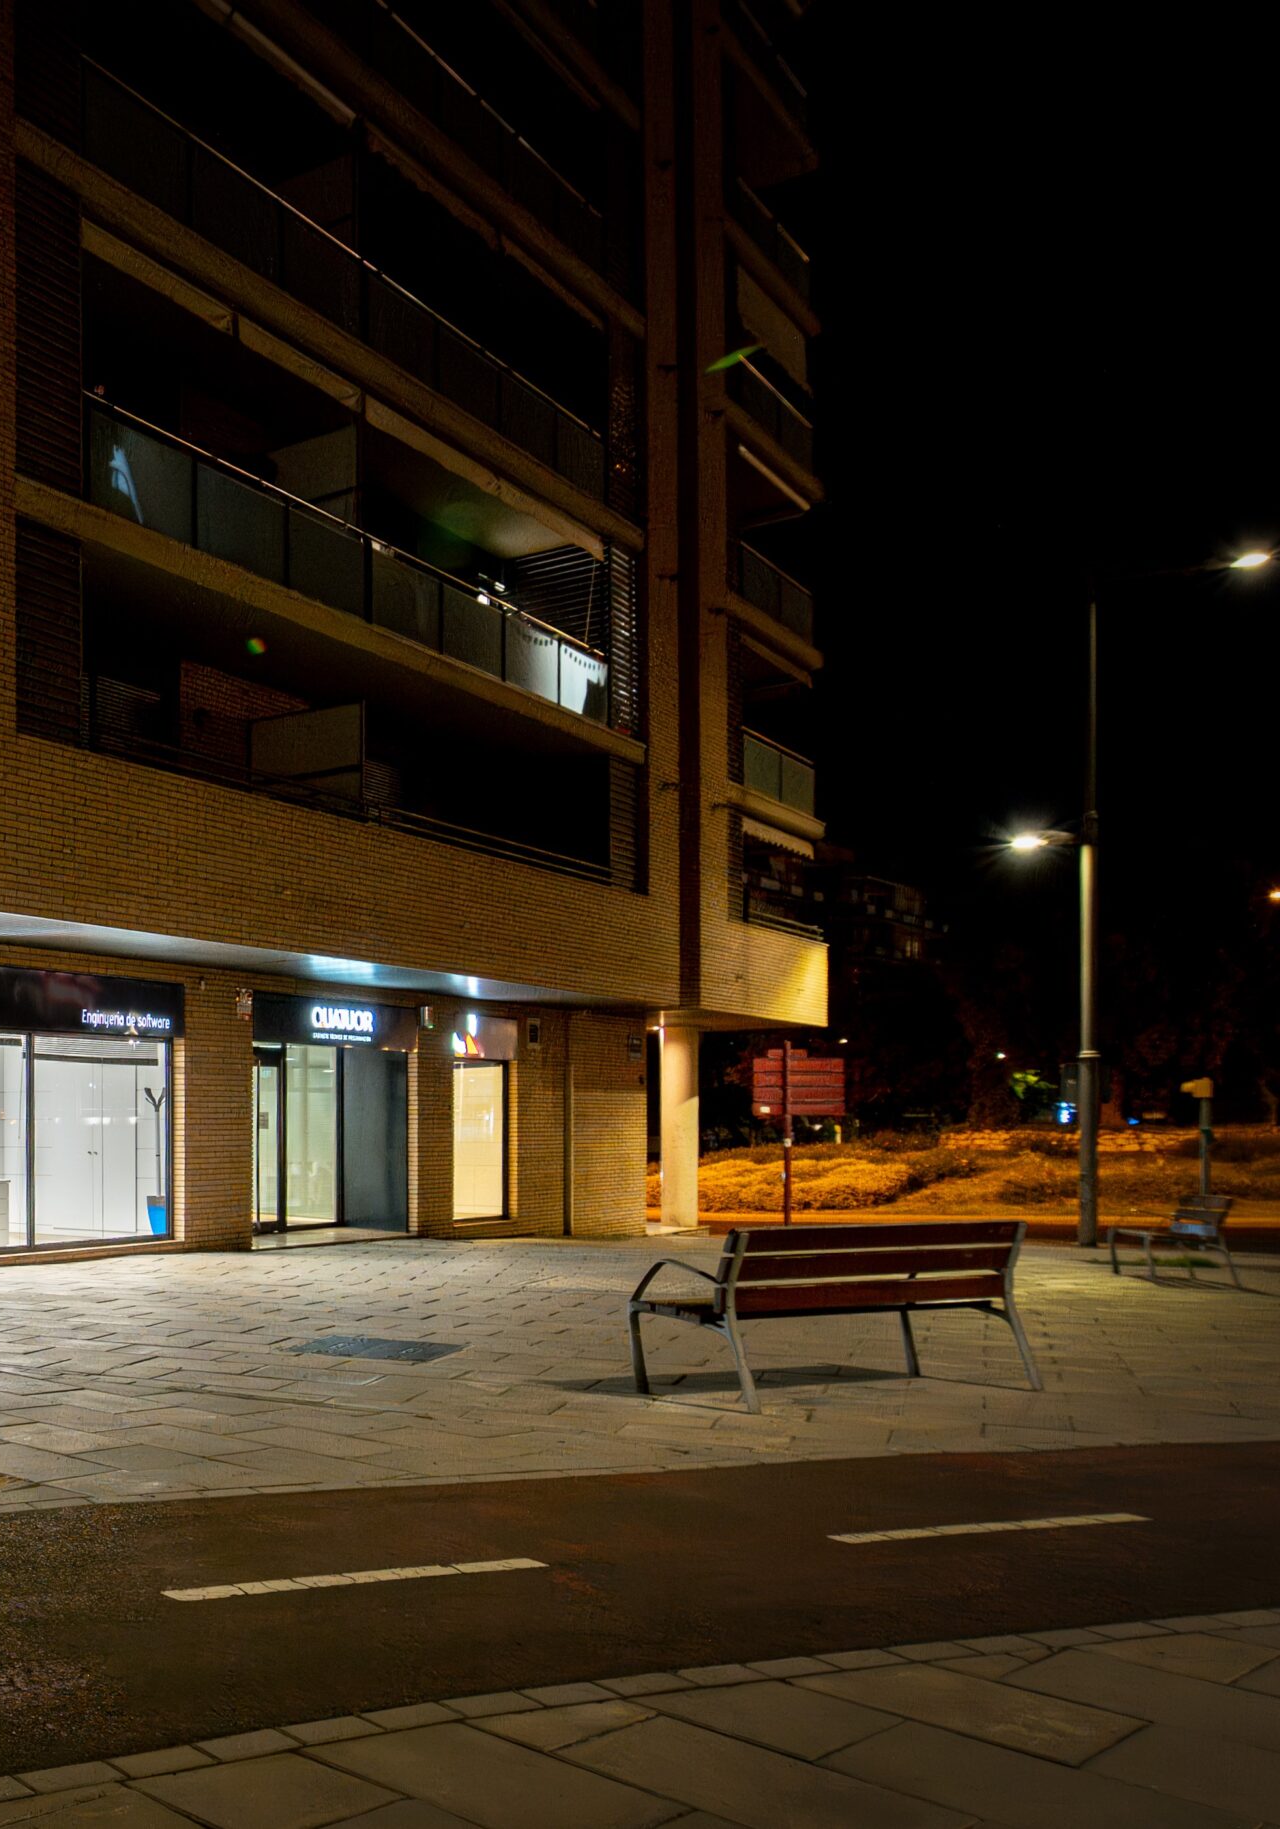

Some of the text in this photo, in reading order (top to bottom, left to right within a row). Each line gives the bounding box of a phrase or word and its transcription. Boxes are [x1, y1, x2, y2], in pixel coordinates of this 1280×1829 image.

[82, 1009, 170, 1029] Enginyeria de software
[311, 1006, 374, 1033] QUATUOR
